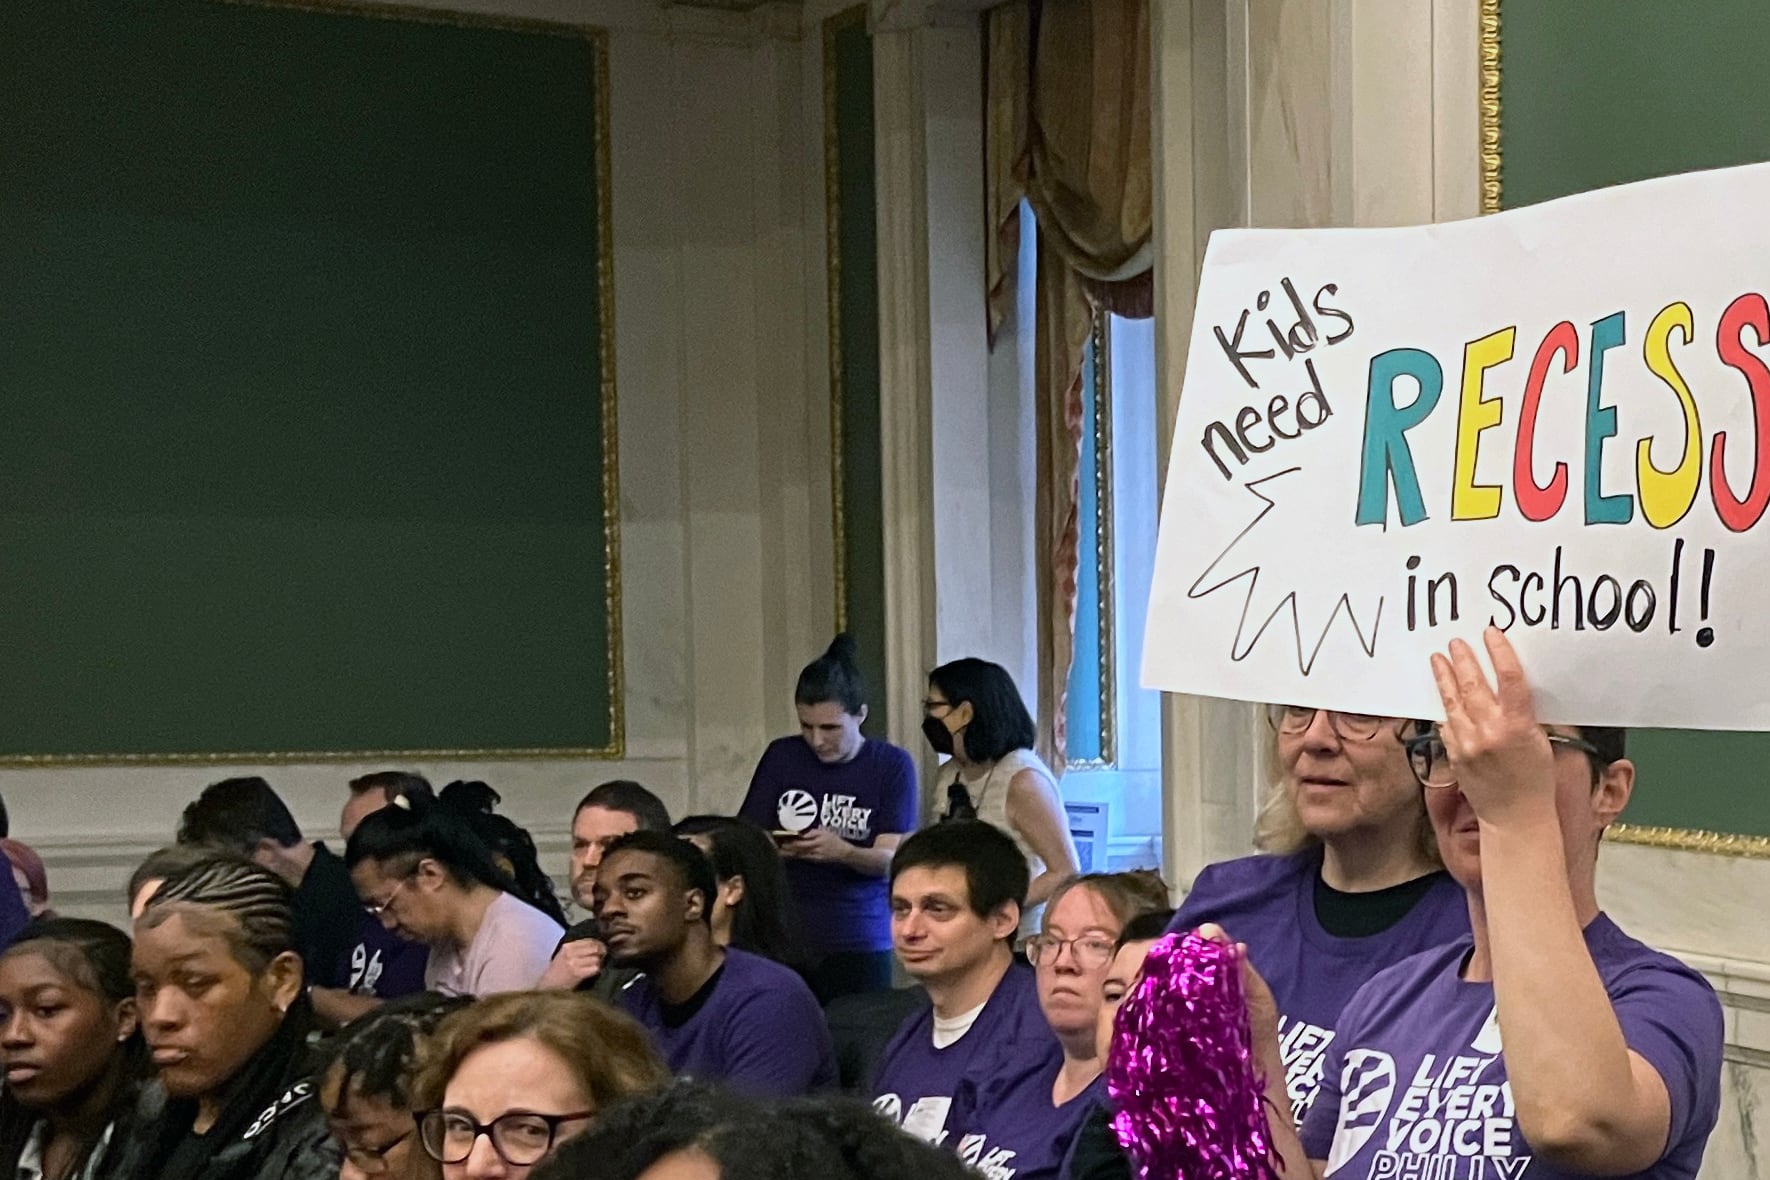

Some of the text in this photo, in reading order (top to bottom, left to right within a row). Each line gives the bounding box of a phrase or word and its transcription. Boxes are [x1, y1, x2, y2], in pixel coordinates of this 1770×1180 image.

[1213, 277, 1355, 388] Kids
[1201, 359, 1334, 480] need
[1404, 539, 1717, 648] in school!
[1411, 1053, 1498, 1089] LIFT
[1386, 1118, 1513, 1157] VOICE
